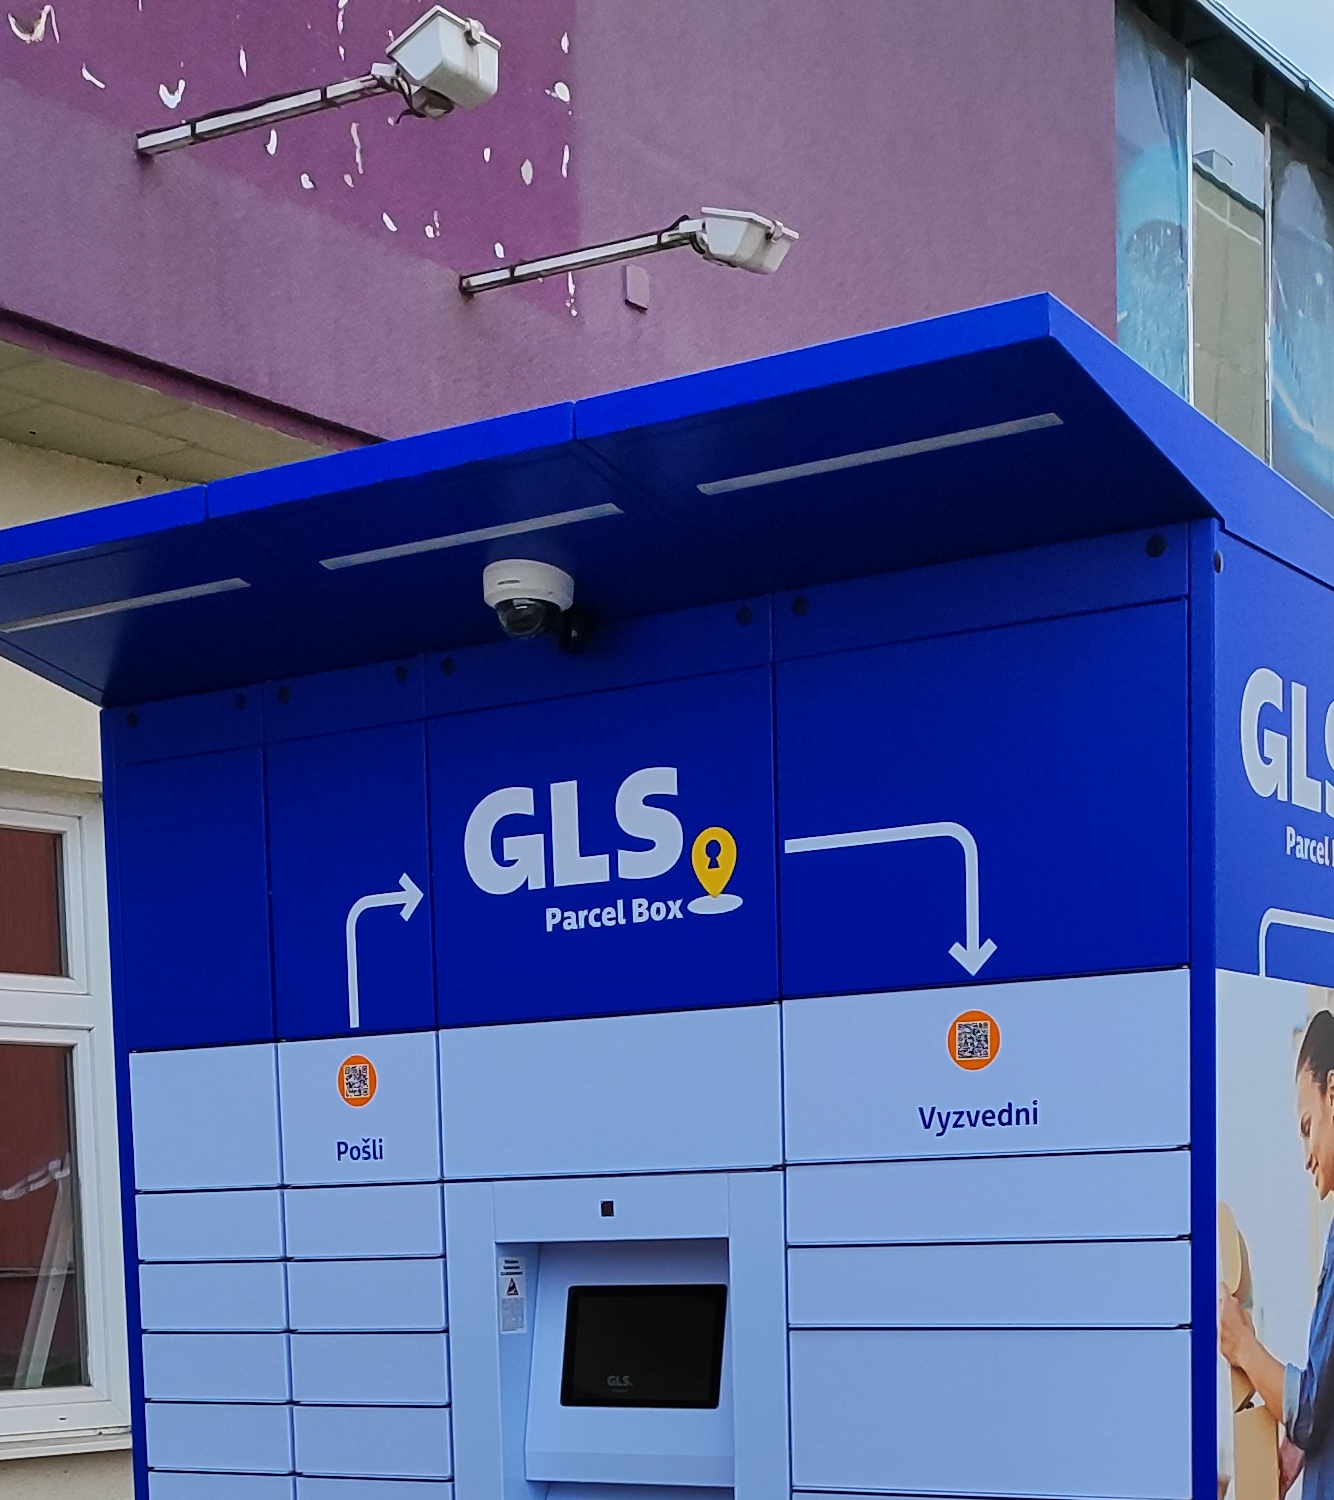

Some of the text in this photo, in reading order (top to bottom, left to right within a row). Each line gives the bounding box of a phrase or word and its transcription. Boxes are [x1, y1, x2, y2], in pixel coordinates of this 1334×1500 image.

[464, 767, 684, 895] GLS
[1286, 825, 1330, 867] Parcel
[545, 898, 684, 932] Parcel Box
[918, 1099, 1038, 1137] Vyzvedni
[336, 1138, 384, 1161] Pošli
